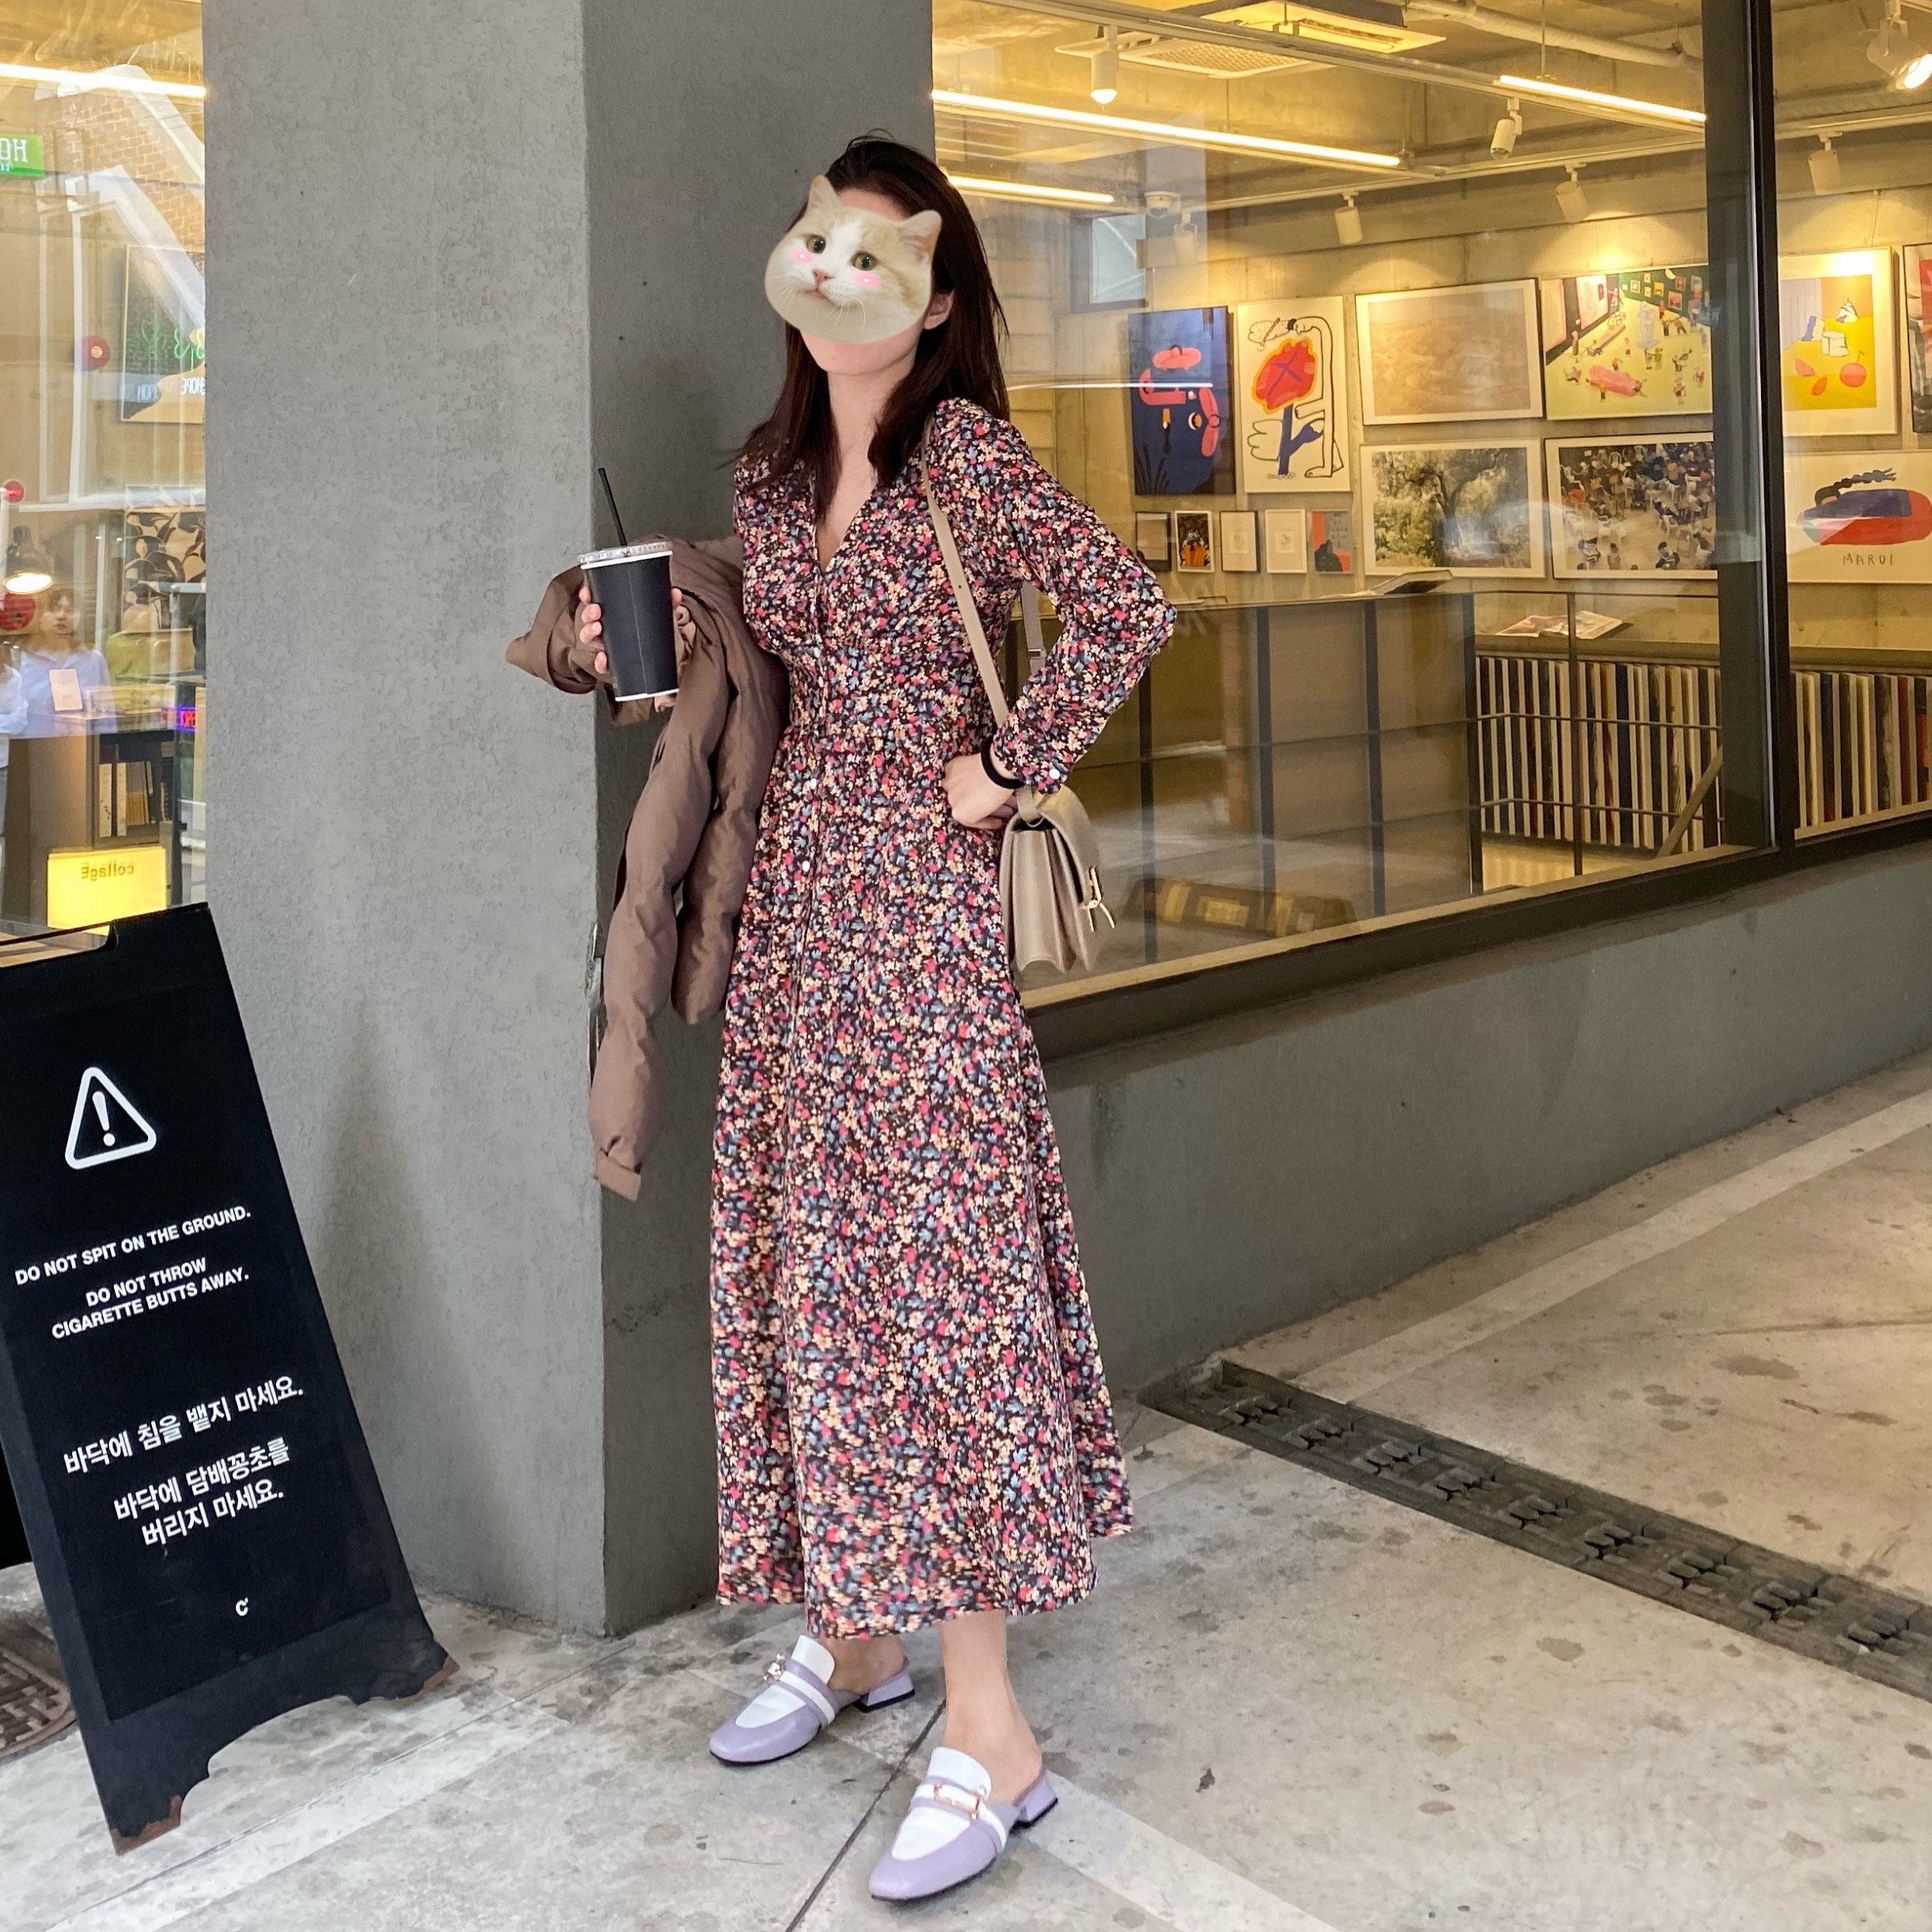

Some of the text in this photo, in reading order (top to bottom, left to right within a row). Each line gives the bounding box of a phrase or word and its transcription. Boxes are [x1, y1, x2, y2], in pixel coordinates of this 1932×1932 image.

[15, 1205, 252, 1285] DO NOT SPIT ON THE GROUND.
[85, 1258, 207, 1308] DO NOT THROW
[51, 1266, 249, 1339] CIGARETTE BUTTS AWAY.
[63, 1376, 304, 1474] 바닥에 침을 뱉지 마세요.
[113, 1437, 290, 1520] 바닥에 담배꽁초를
[141, 1478, 284, 1547] 버리지 마세요.
